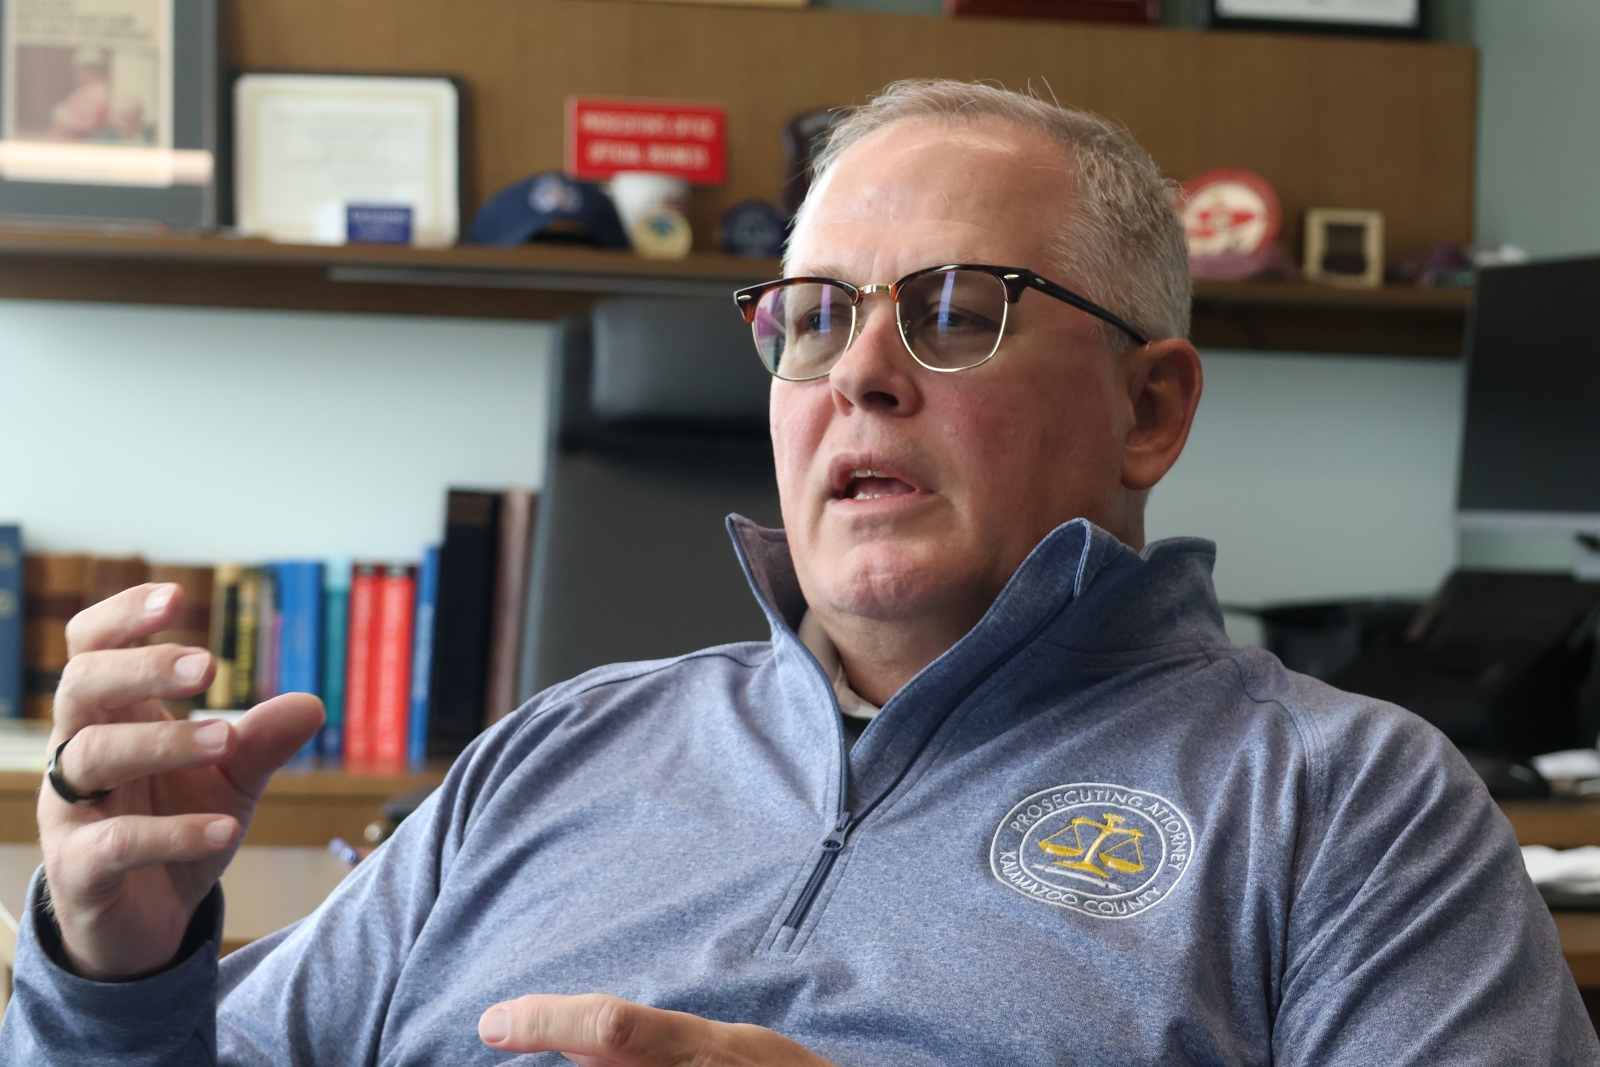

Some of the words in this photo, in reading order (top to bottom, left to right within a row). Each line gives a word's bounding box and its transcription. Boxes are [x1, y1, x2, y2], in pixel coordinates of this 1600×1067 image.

[1010, 789, 1143, 832] PROSECUTING
[1144, 802, 1187, 870] ATTORNEY
[999, 851, 1077, 904] KALAMAZOO
[1084, 886, 1161, 914] COUNTY
